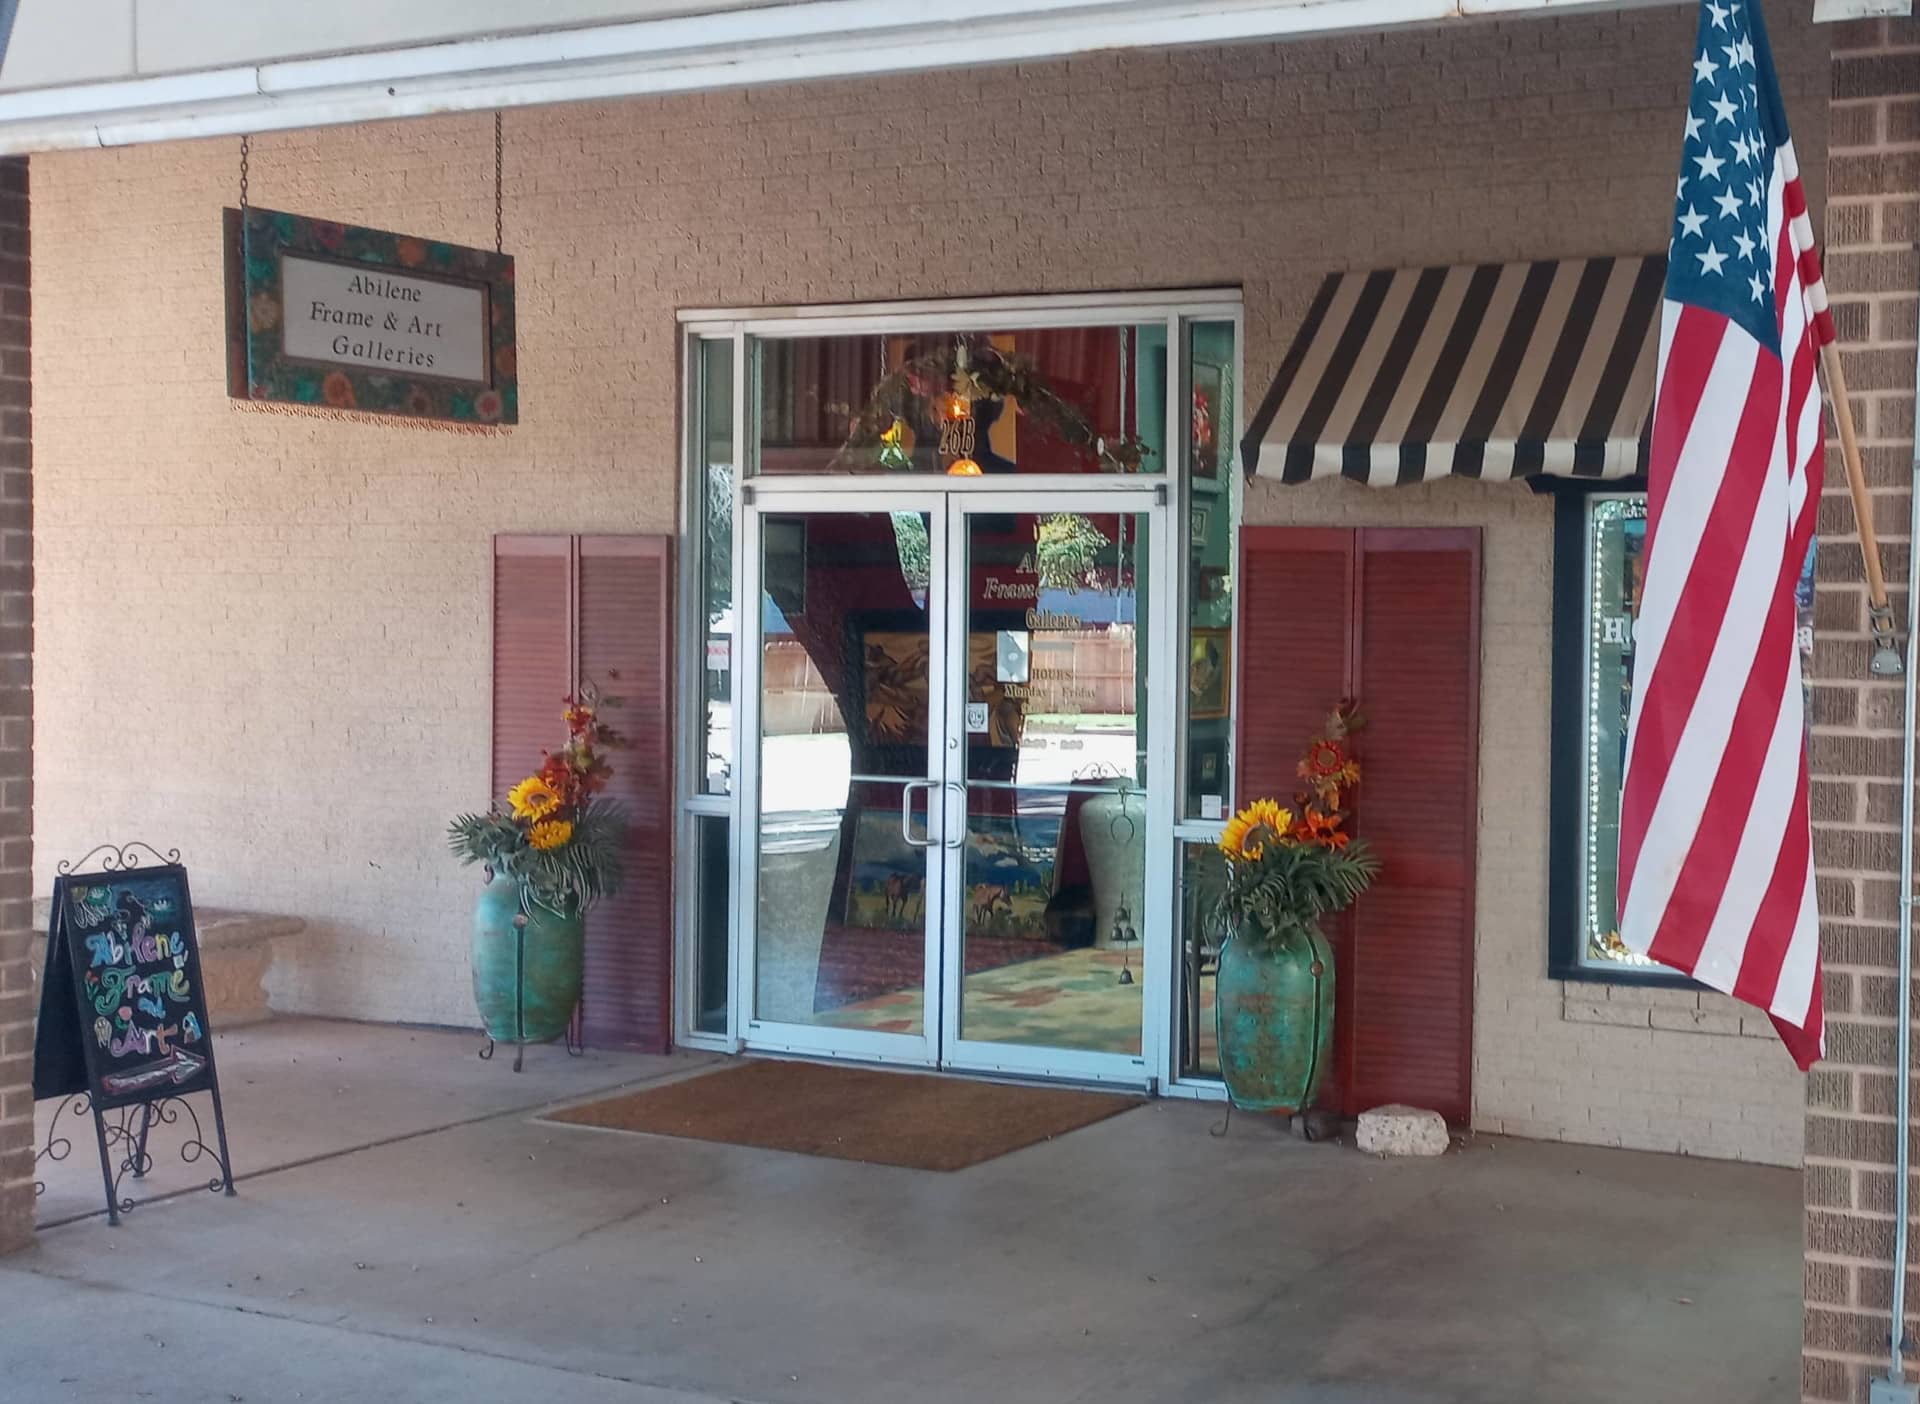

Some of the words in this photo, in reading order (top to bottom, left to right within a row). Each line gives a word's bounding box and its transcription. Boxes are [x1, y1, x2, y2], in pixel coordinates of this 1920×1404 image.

[348, 275, 422, 302] Abilene
[310, 301, 374, 328] Frame
[383, 312, 400, 332] &
[408, 315, 442, 338] Art
[332, 336, 435, 367] Galleries
[938, 417, 976, 455] 26B
[1026, 607, 1081, 629] Galleries
[1032, 669, 1072, 681] HOURS
[86, 922, 184, 967] Abilene
[95, 965, 191, 1016] Frame
[111, 1019, 178, 1058] Art
